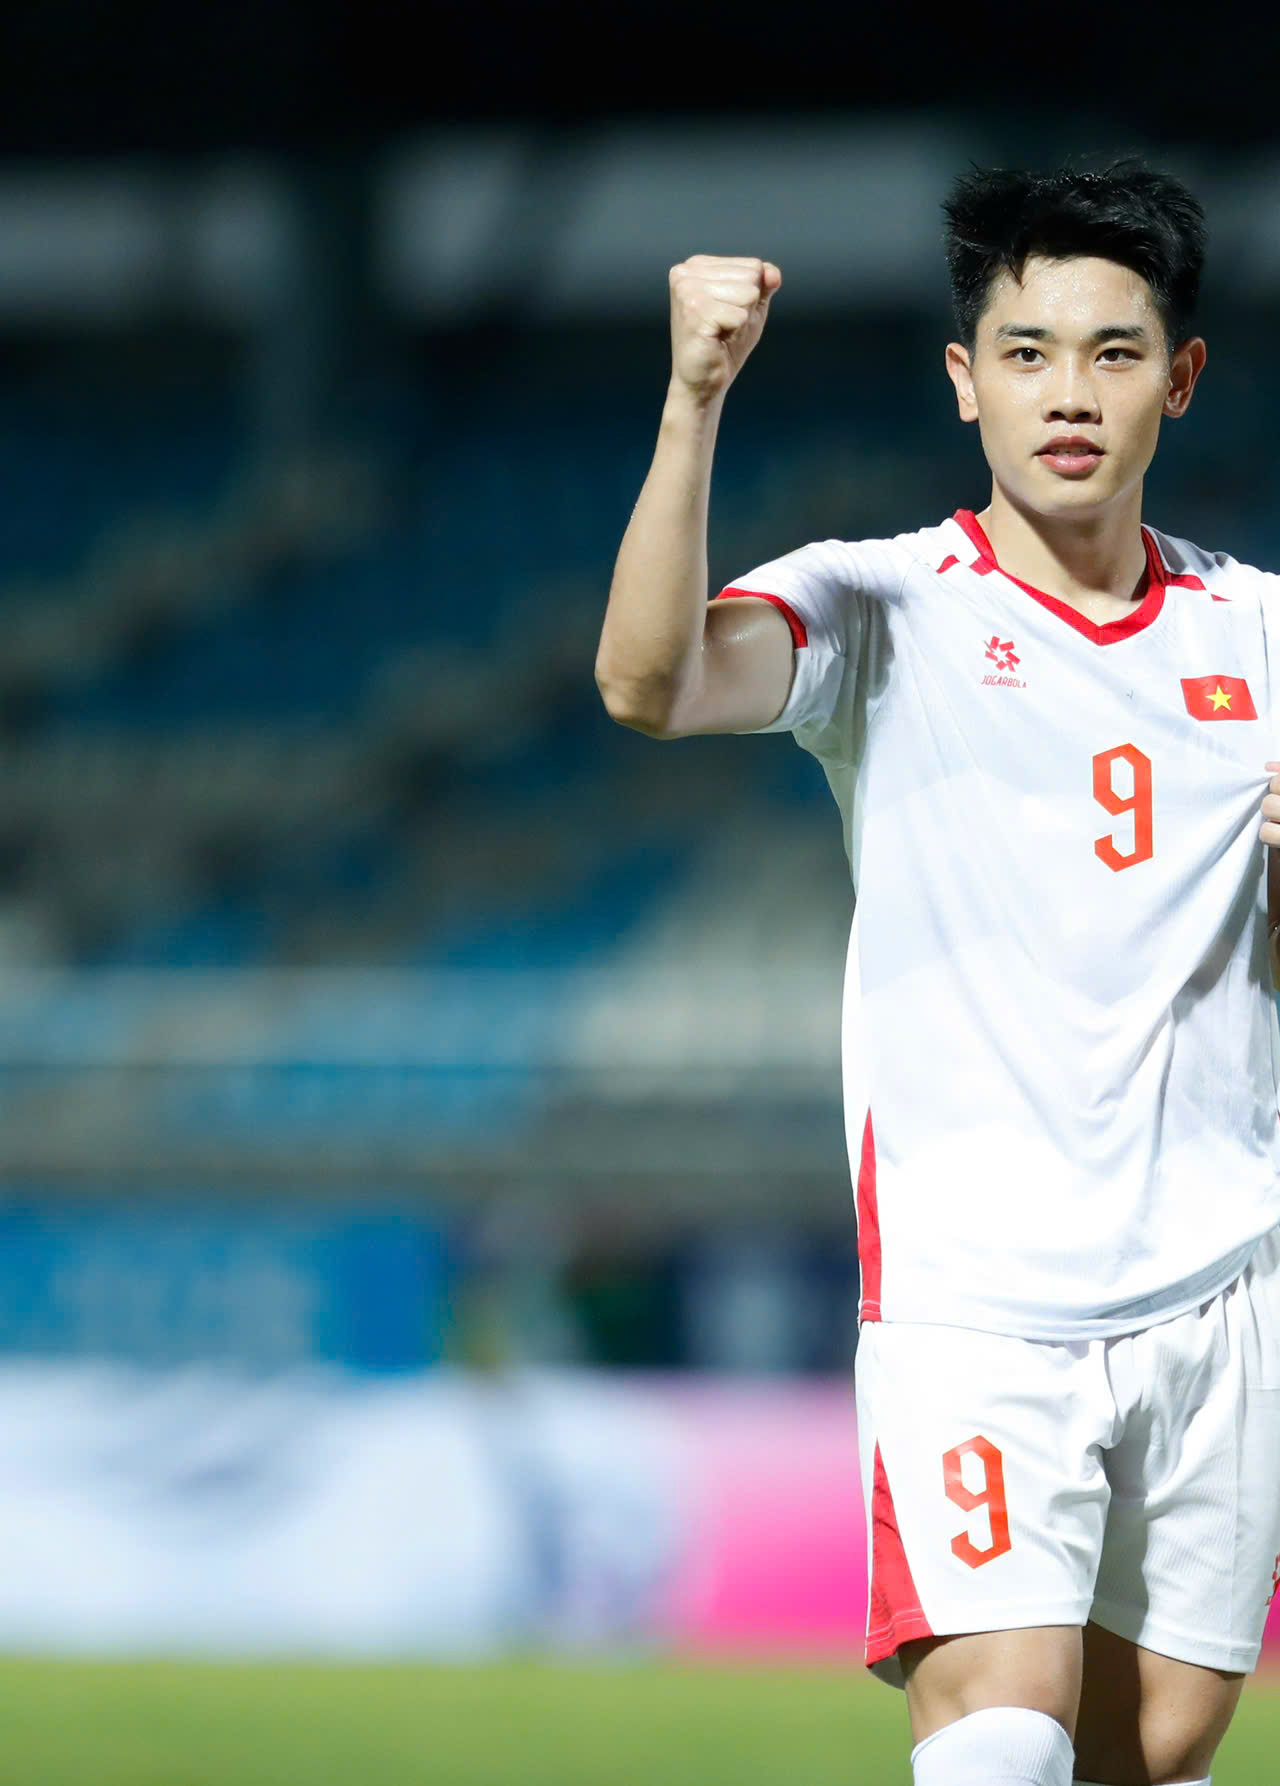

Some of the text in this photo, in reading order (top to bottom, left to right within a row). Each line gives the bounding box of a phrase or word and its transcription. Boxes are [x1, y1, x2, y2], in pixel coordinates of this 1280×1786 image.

[981, 674, 1027, 689] JOGARBOLA
[1092, 743, 1153, 873] 9
[942, 1434, 1012, 1569] 9
